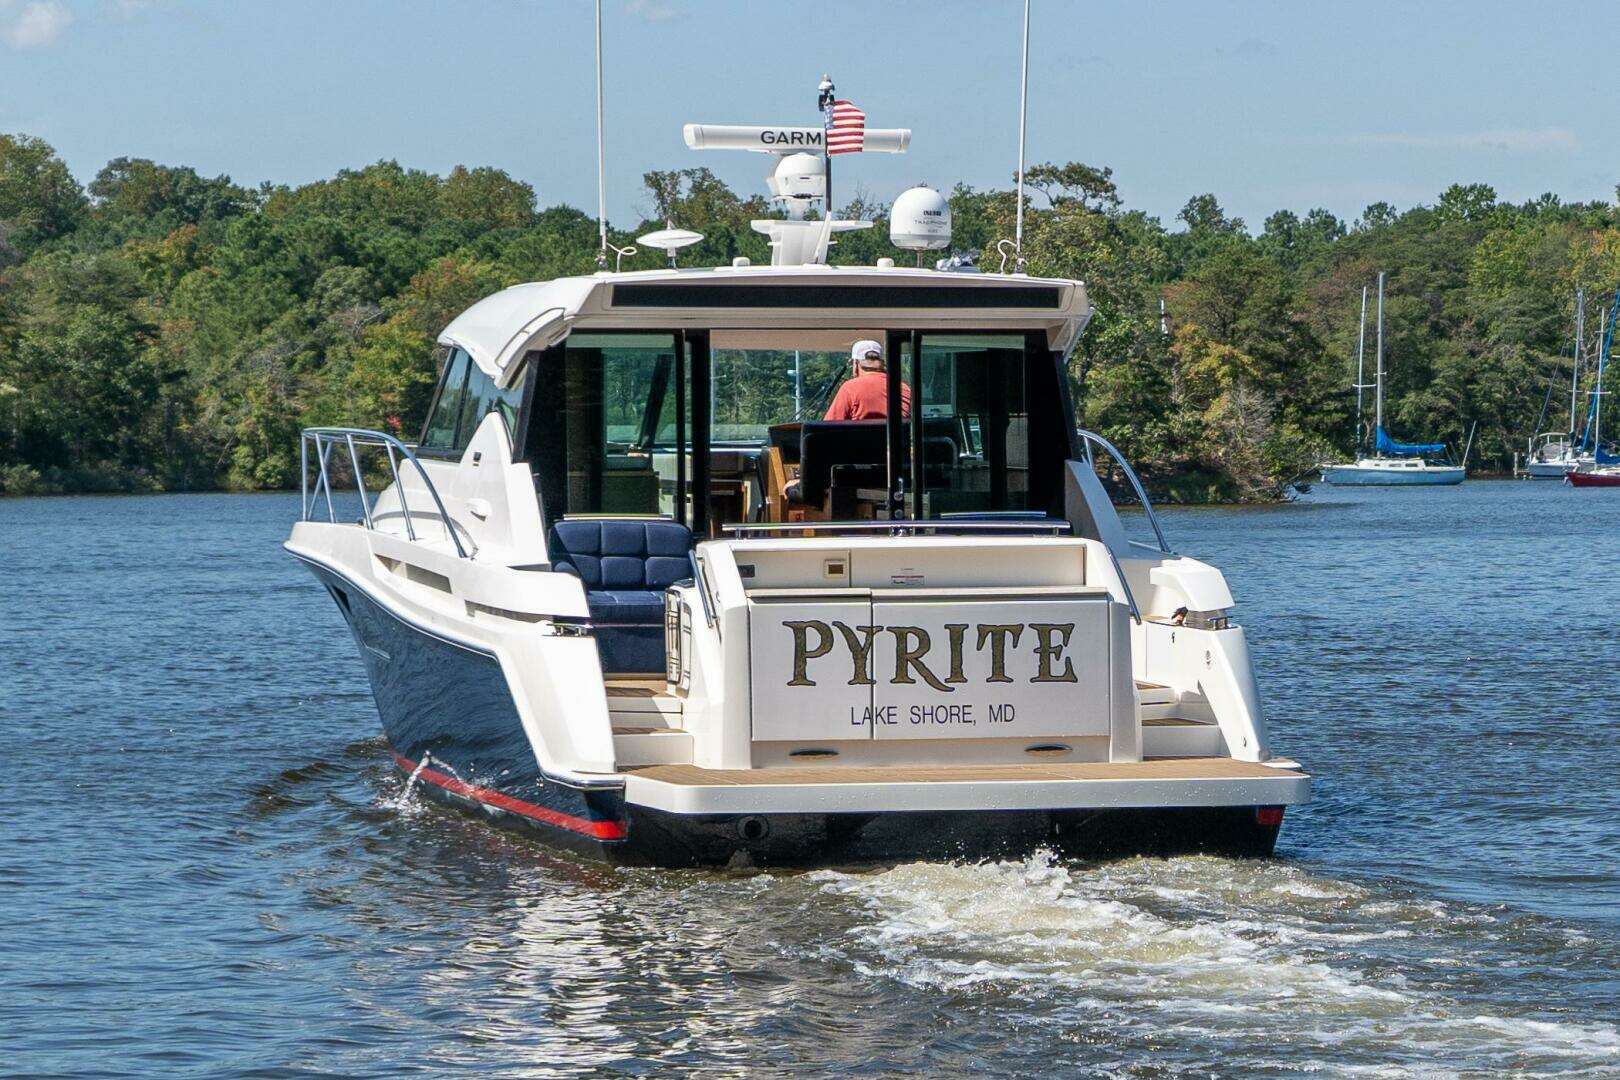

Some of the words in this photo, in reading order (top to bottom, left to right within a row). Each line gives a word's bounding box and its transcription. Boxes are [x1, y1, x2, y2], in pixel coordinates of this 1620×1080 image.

[761, 131, 822, 145] GARM
[782, 620, 1078, 692] PYRITE
[851, 707, 898, 725] LAKE
[910, 705, 976, 726] SHORE,
[989, 704, 1015, 723] MD
